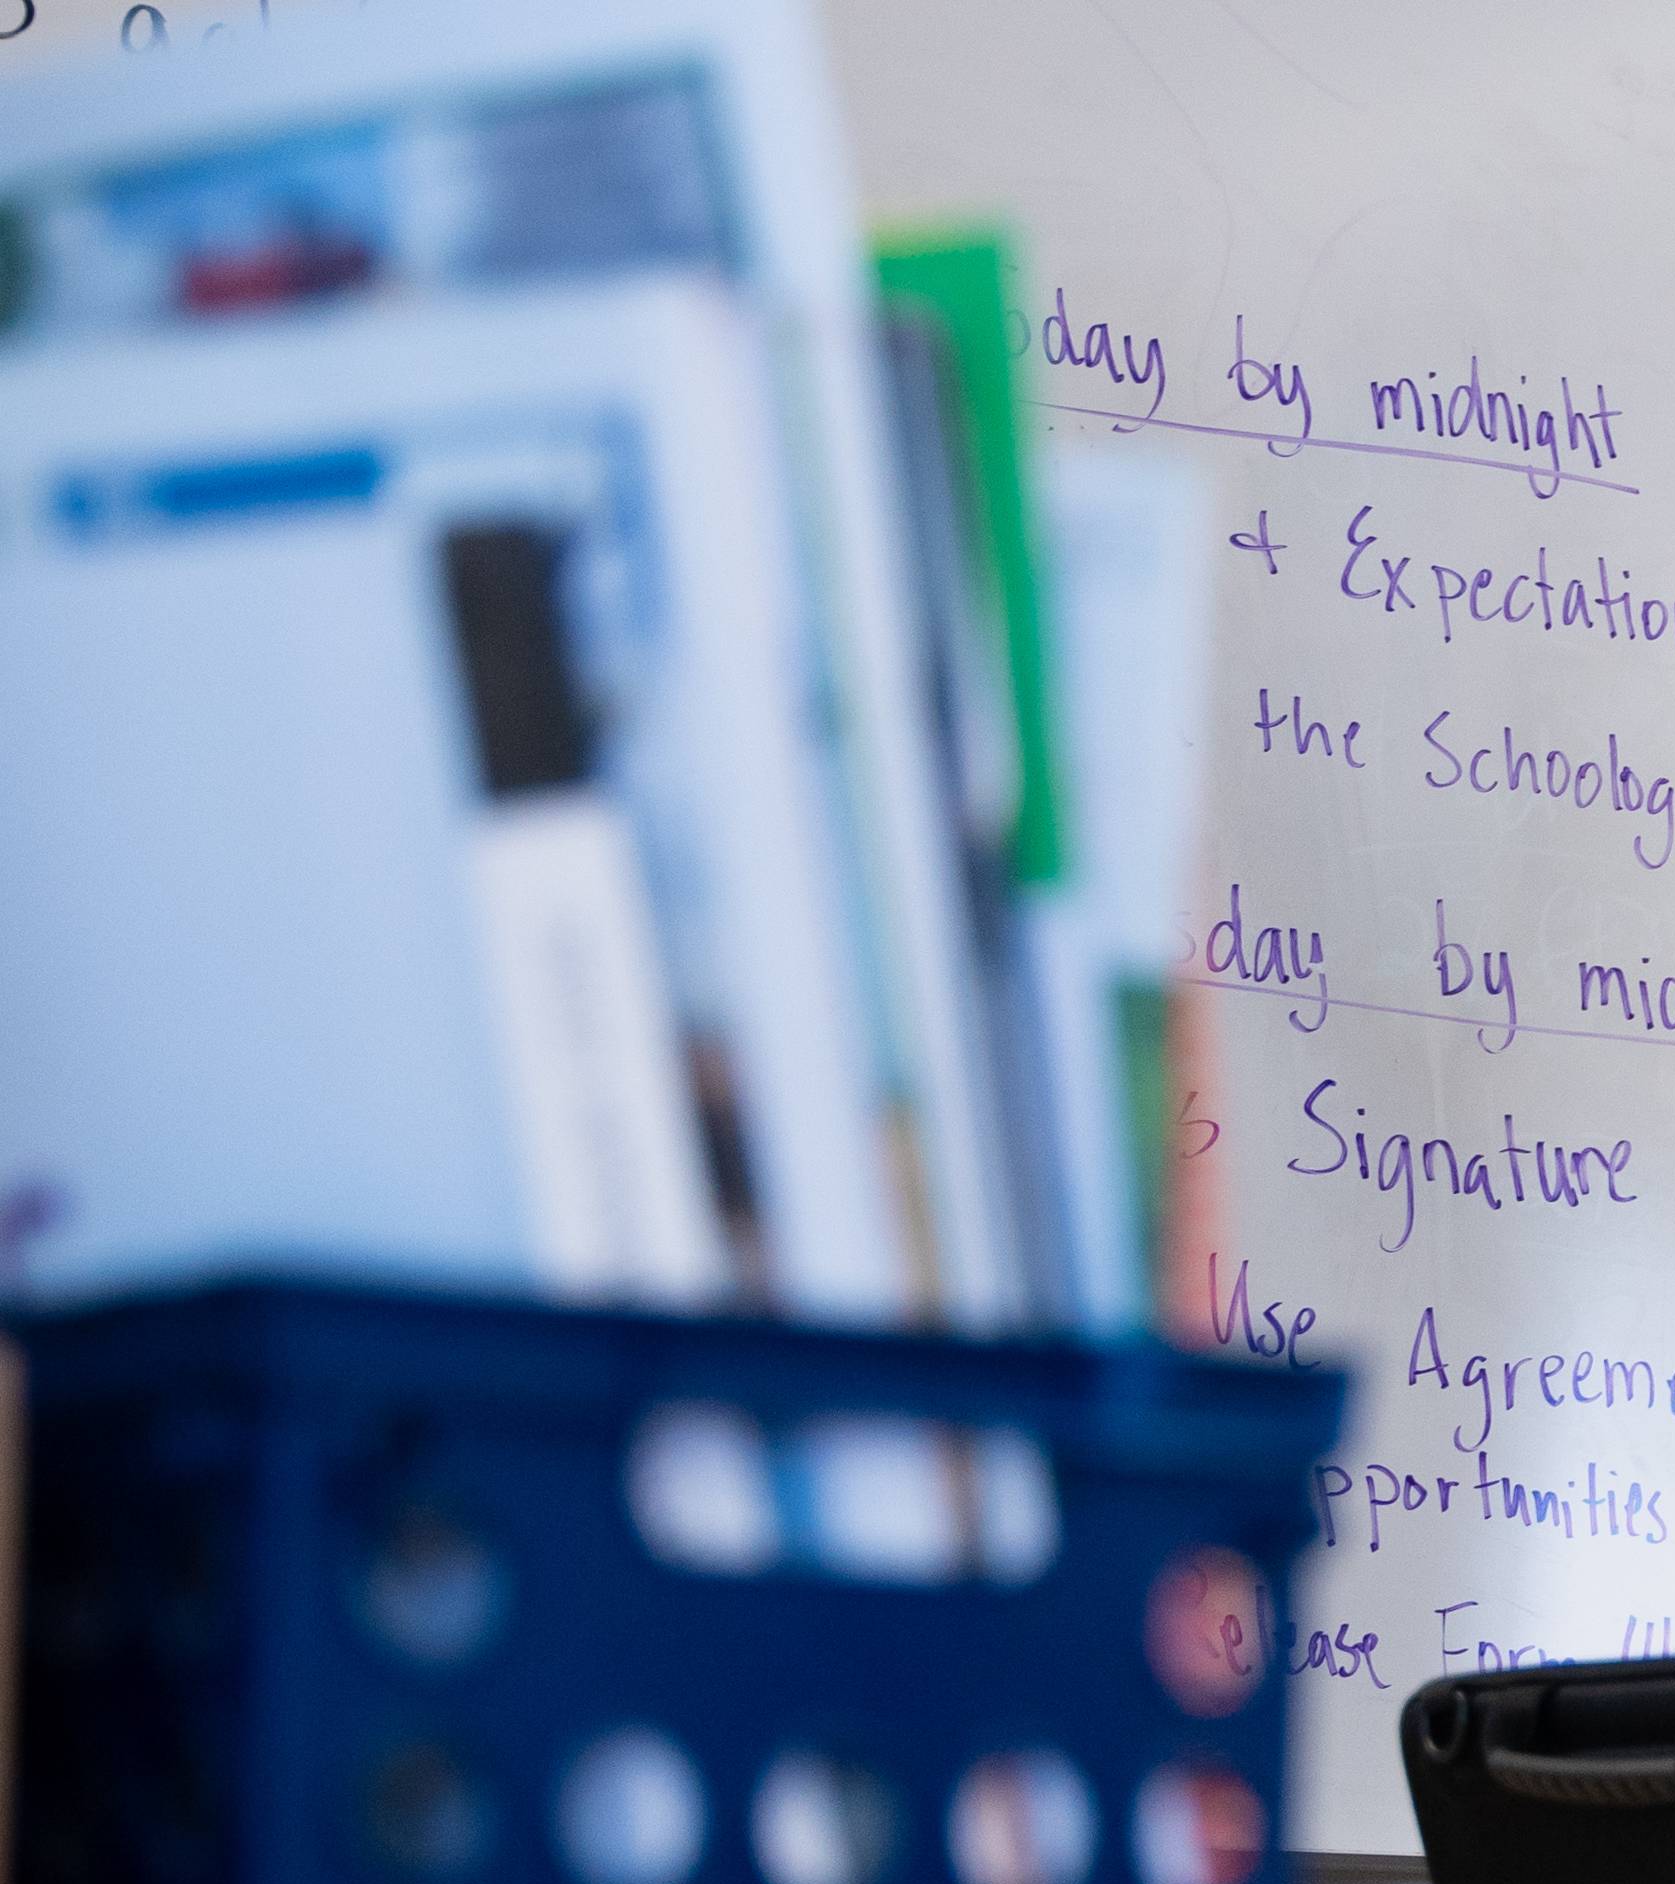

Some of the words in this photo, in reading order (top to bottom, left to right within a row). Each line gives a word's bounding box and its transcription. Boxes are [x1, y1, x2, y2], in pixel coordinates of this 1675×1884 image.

[1228, 316, 1310, 459] by
[1372, 356, 1625, 499] midnight
[1254, 688, 1367, 770] the
[1170, 883, 1328, 1033] sday
[1435, 899, 1517, 1054] by
[1286, 1079, 1639, 1252] Signature
[1208, 1252, 1321, 1370] Use
[1313, 1452, 1668, 1552] pportunities
